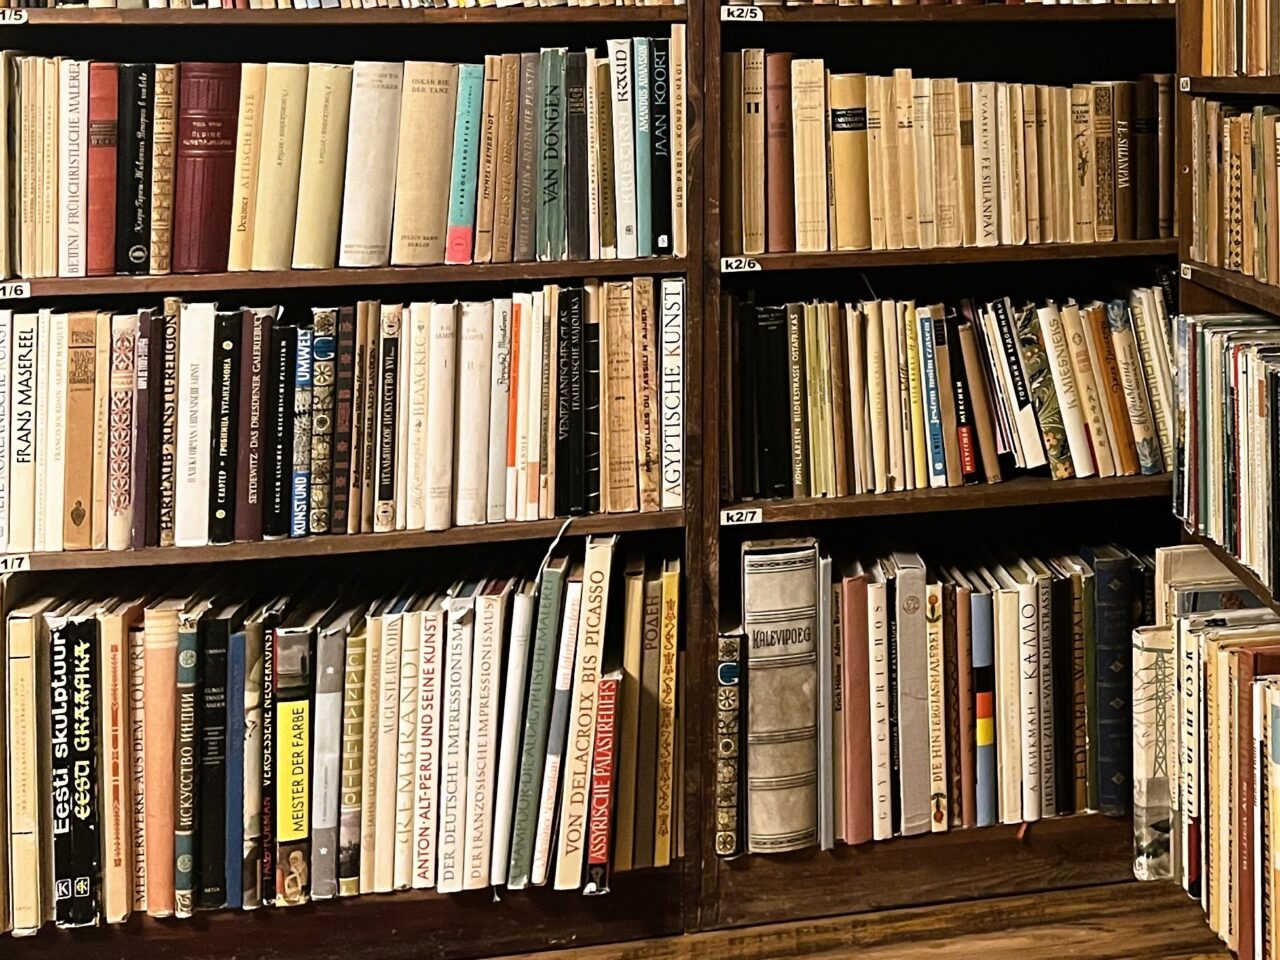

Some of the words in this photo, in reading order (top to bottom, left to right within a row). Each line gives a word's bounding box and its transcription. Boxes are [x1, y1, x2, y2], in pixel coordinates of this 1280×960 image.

[726, 7, 758, 19] k2/5
[638, 44, 648, 88] ADAMSON
[653, 47, 667, 106] KOORT
[244, 93, 255, 128] FESTE
[543, 83, 560, 161] DONGEN
[639, 88, 648, 133] AMANDUS
[654, 113, 668, 157] JAAN
[240, 131, 252, 190] ATTISCHE
[543, 168, 561, 207] VAN
[67, 234, 81, 274] BETTINI
[725, 258, 756, 270] k2/6
[560, 309, 570, 339] GLAS
[571, 296, 580, 344] MAJOLIKA
[790, 313, 800, 362] OSTAFRIKAS
[17, 327, 34, 406] MASEREEL
[557, 341, 570, 441] VENEZIANISCHES
[571, 346, 581, 410] ITALIENISCHE
[792, 364, 801, 422] BILDERSTRASSE
[16, 409, 32, 463] FRANS
[219, 416, 229, 457] ГРОБНИЦА
[793, 428, 802, 486] KOHL-LARSEN
[294, 476, 307, 499] UND
[293, 500, 306, 535] KUNST
[726, 512, 757, 523] k2/7
[586, 570, 605, 648] PICASSO
[644, 595, 660, 651] РОДЕН
[1040, 584, 1050, 632] STRASSE
[423, 615, 437, 664] KUNST
[752, 626, 811, 650] KALEVIPOEG
[1021, 603, 1037, 680] КАЛЛО
[1041, 634, 1051, 660] DER
[131, 637, 145, 710] LOUVRE
[422, 667, 435, 711] SEINE
[583, 654, 597, 684] BIS
[179, 692, 194, 743] ИНДИИ
[928, 631, 942, 759] HINTERGLASMALEREI
[132, 719, 144, 752] DEM
[291, 707, 304, 746] FARBE
[396, 646, 418, 836] REMBRANDT
[421, 713, 433, 748] UND
[567, 692, 594, 805] DELACROIX
[1028, 706, 1038, 776] ГЛИКМАН
[133, 755, 144, 784] AUS
[179, 746, 194, 826] ИСКУССТВО
[291, 749, 304, 776] DER
[931, 762, 943, 783] DIE
[1044, 744, 1054, 808] HEINRICH
[53, 768, 71, 834] Eesti
[291, 780, 305, 832] MEISTER
[590, 780, 609, 861] ASSYRISCHE
[133, 787, 146, 904] MEISTERWERKE
[417, 826, 430, 880] ANTON
[565, 813, 582, 857] VON
